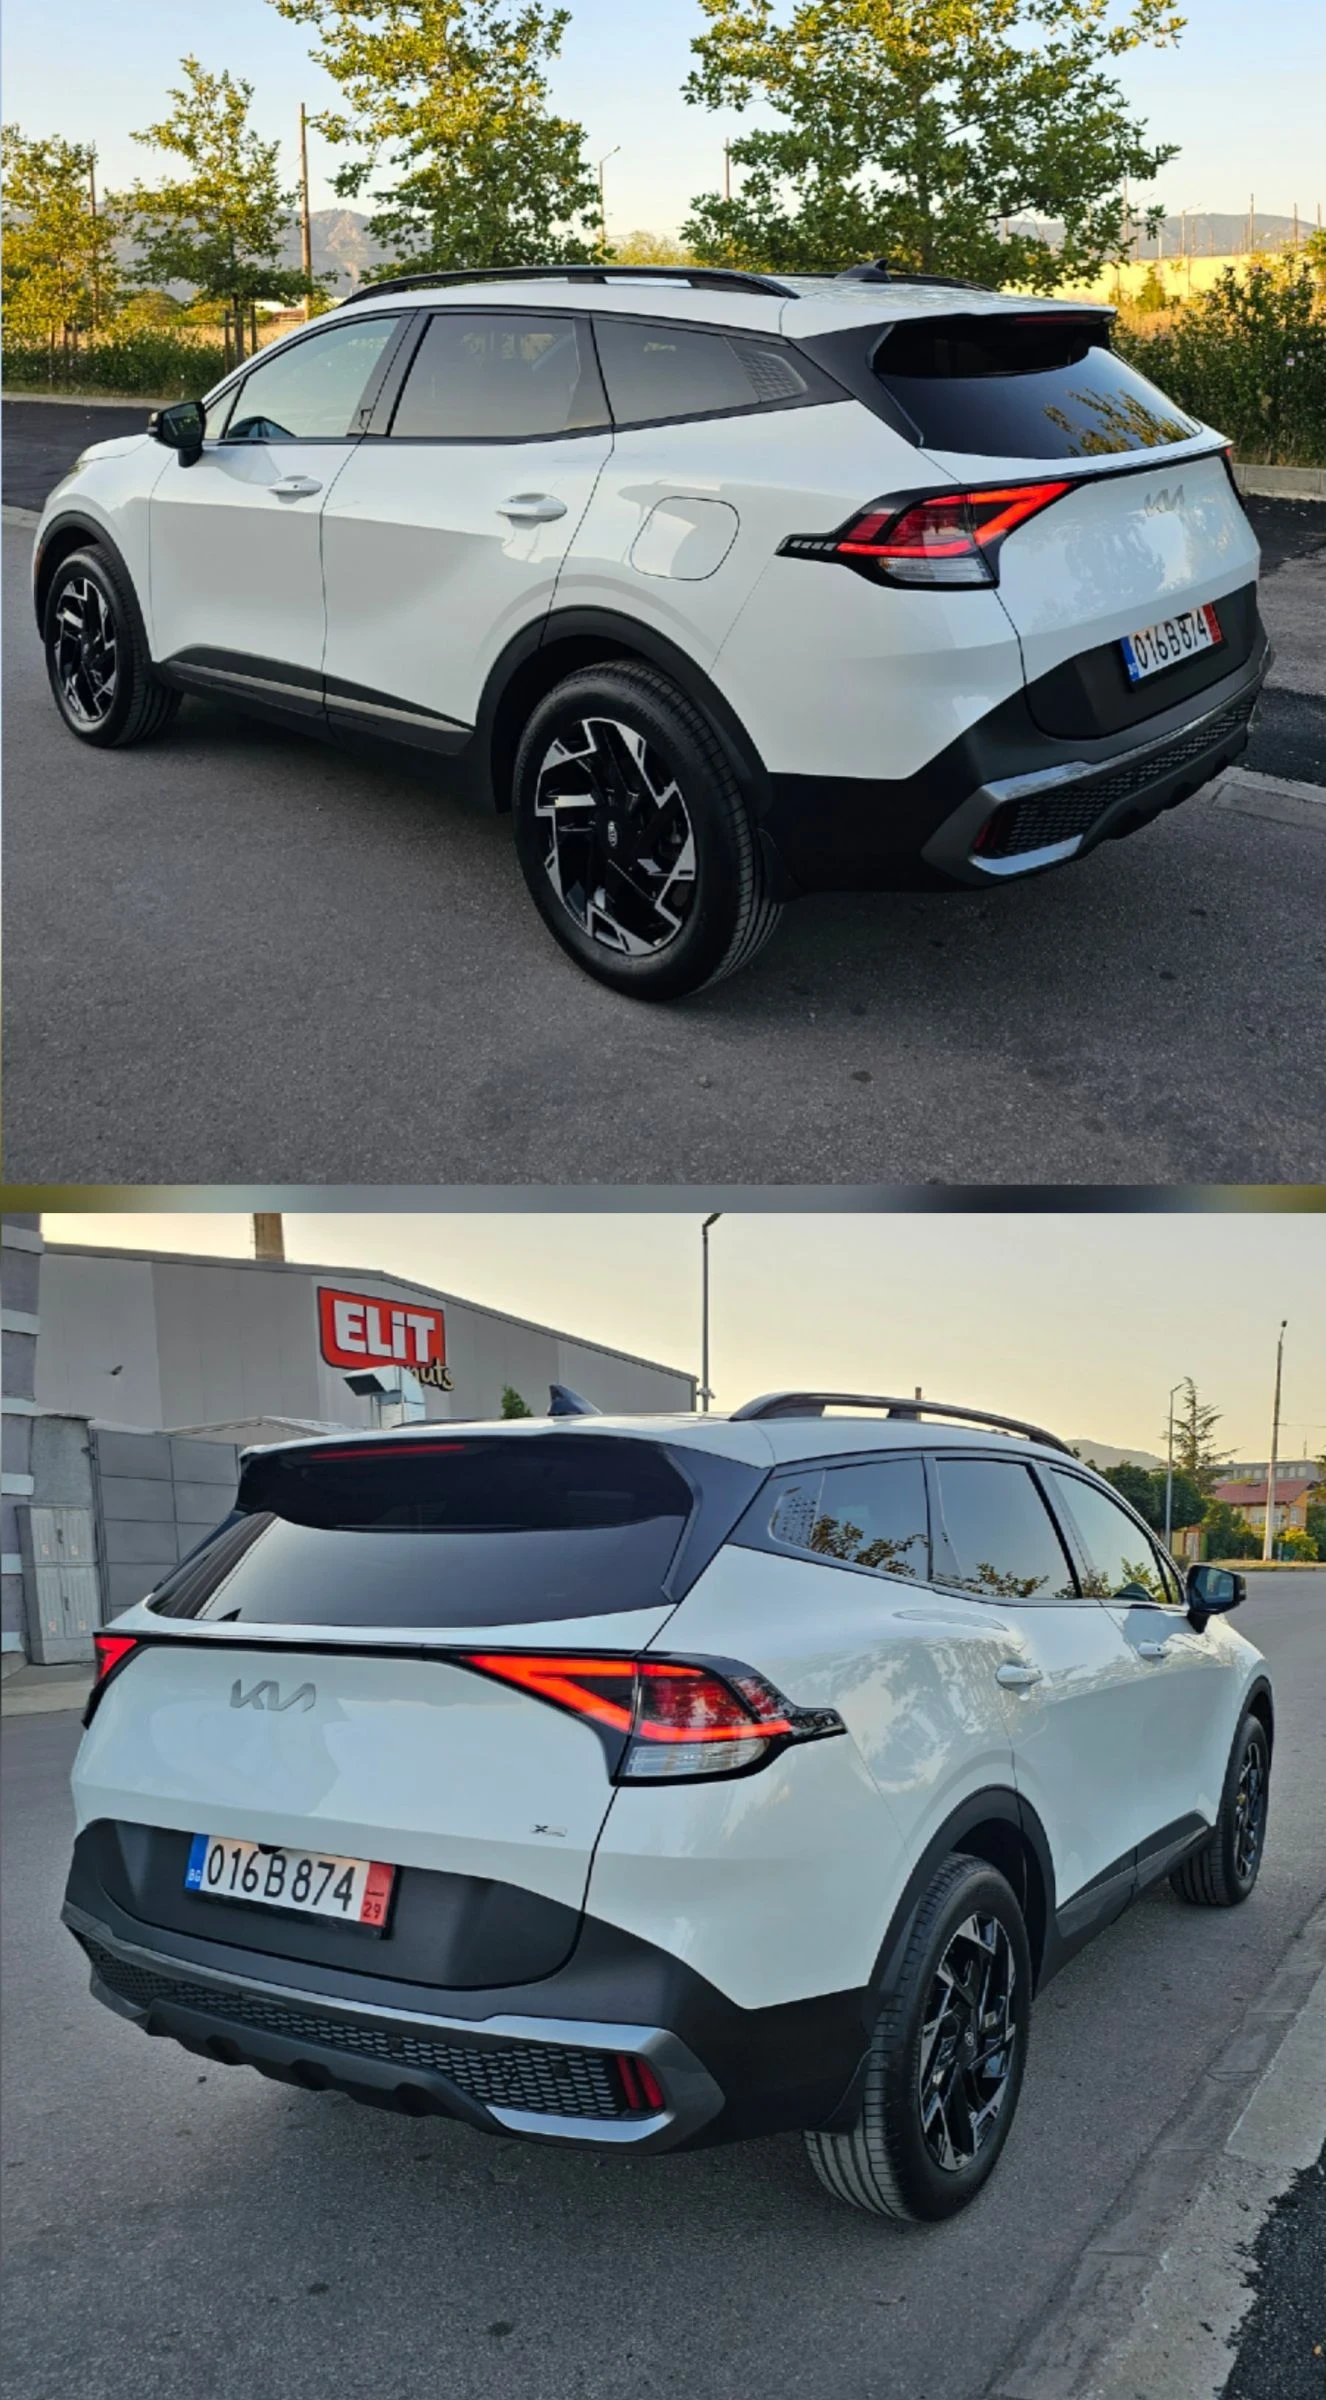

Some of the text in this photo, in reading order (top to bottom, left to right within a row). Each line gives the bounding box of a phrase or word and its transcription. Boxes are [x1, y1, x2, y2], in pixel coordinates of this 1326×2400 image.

[1133, 608, 1209, 670] 016B874
[229, 1678, 316, 1713] KIA
[187, 1868, 202, 1883] BG
[207, 1843, 356, 1912] 016B874
